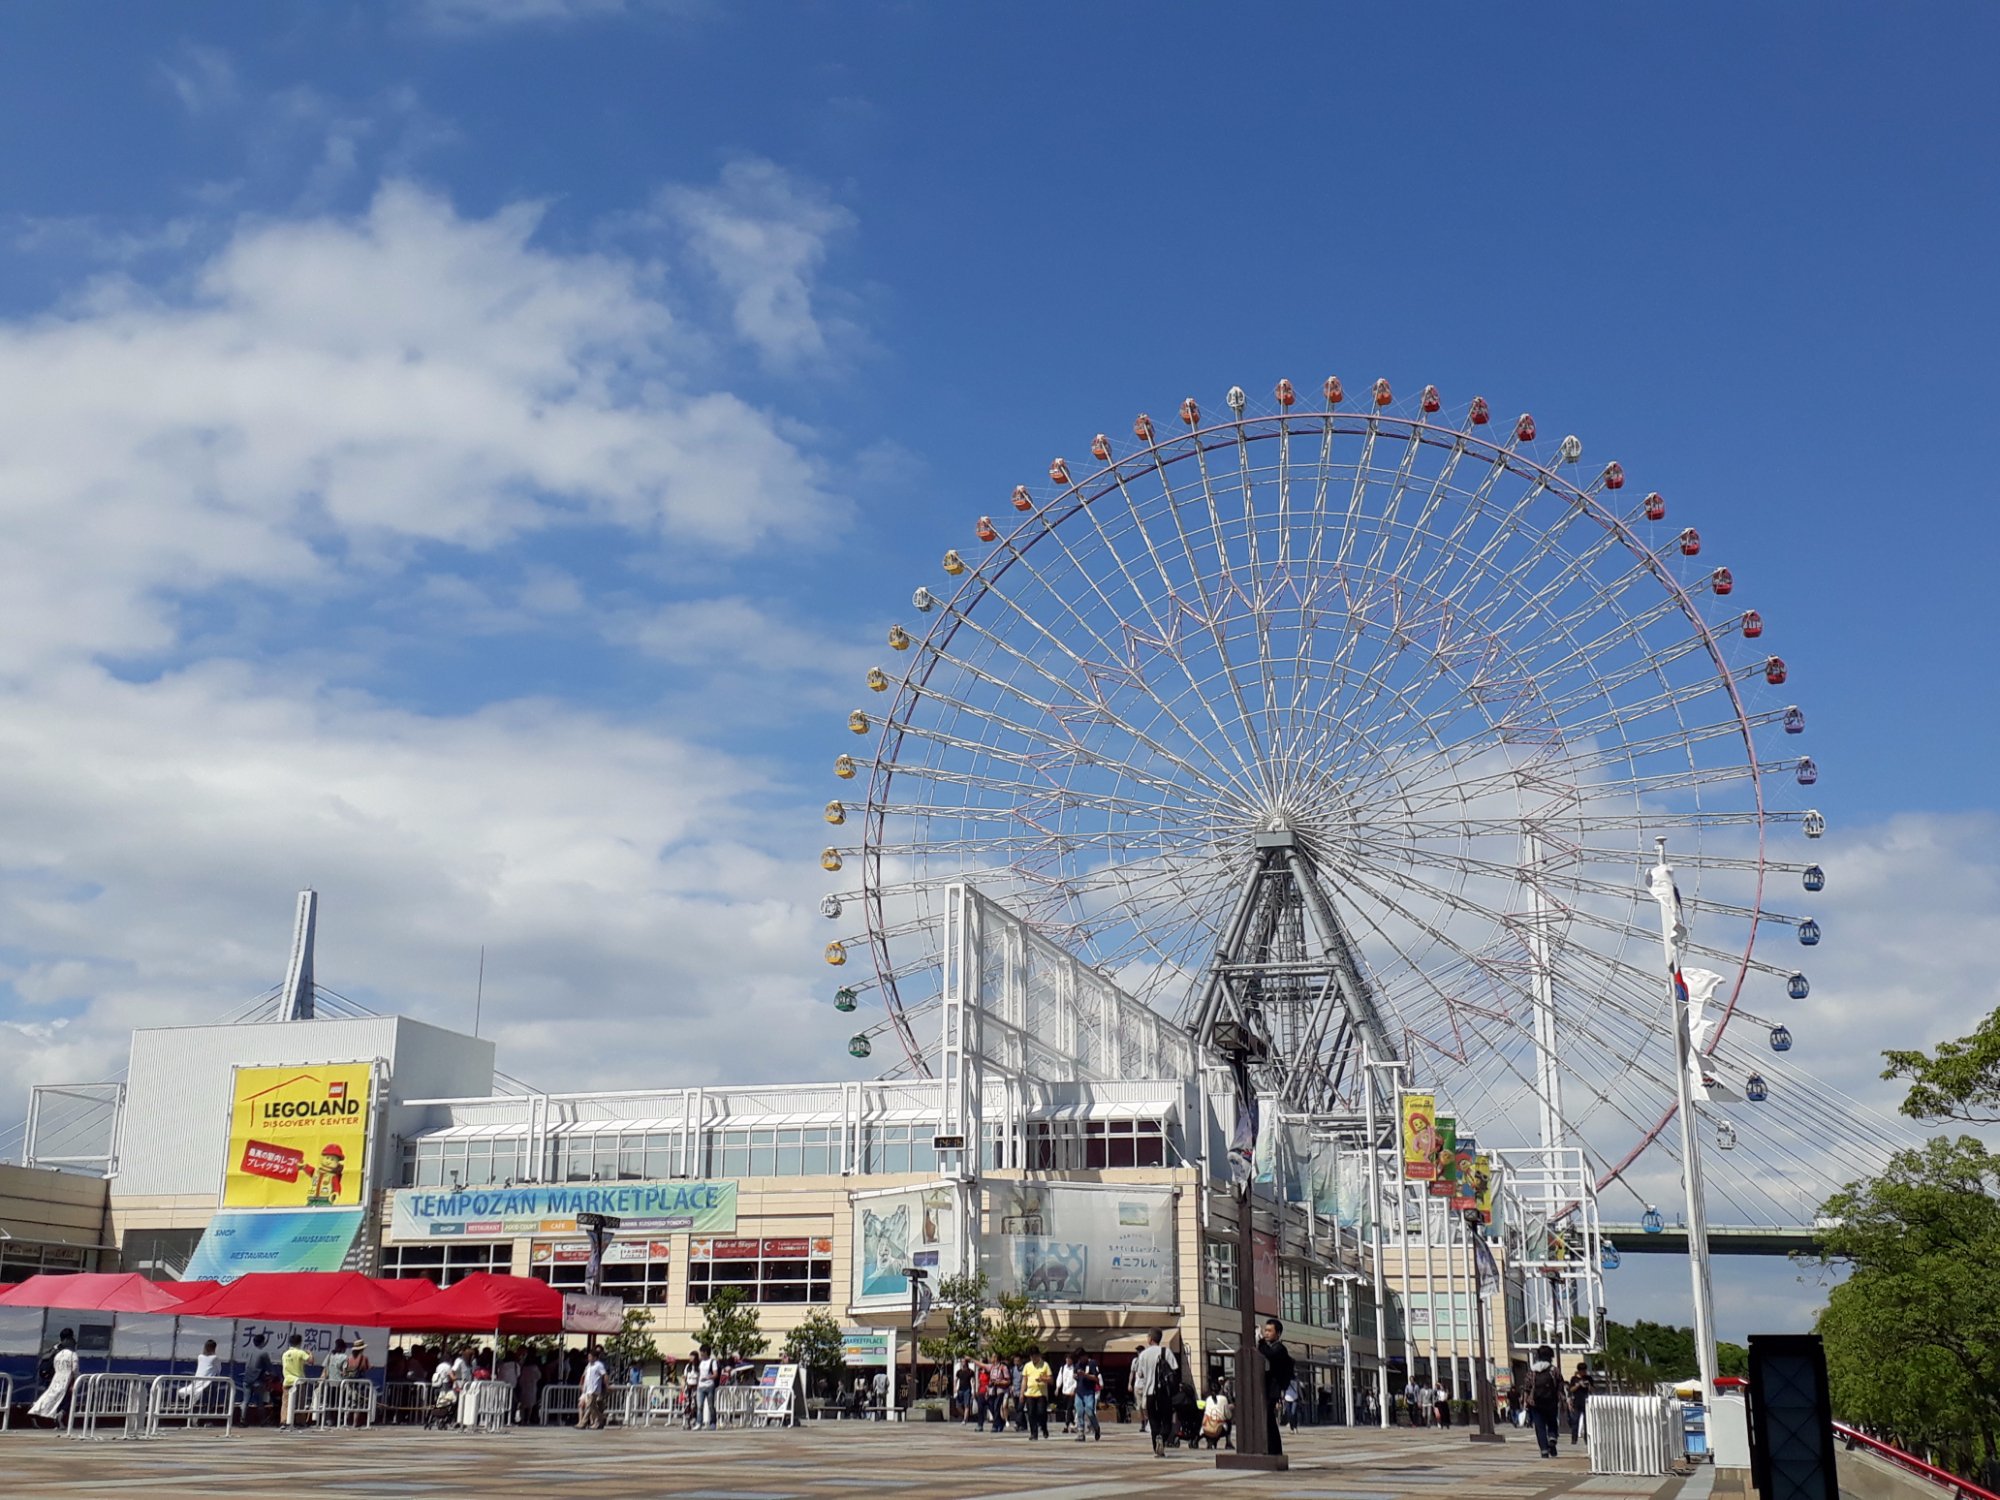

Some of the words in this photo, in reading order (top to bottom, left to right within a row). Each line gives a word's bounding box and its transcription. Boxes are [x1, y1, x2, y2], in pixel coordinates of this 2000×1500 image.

[264, 1082, 359, 1118] LEGOLAND
[263, 1118, 316, 1128] DISCOVERY
[320, 1116, 359, 1126] CENTER
[410, 1191, 536, 1217] TEMPOZAN
[547, 1185, 719, 1213] MARKETPLACE
[214, 1229, 236, 1237] SHOP
[292, 1235, 341, 1243] AMUSEMENT
[229, 1252, 280, 1260] RESTAURANT
[1122, 1257, 1158, 1268] ニフレル
[242, 1325, 332, 1351] チケッ窓口
